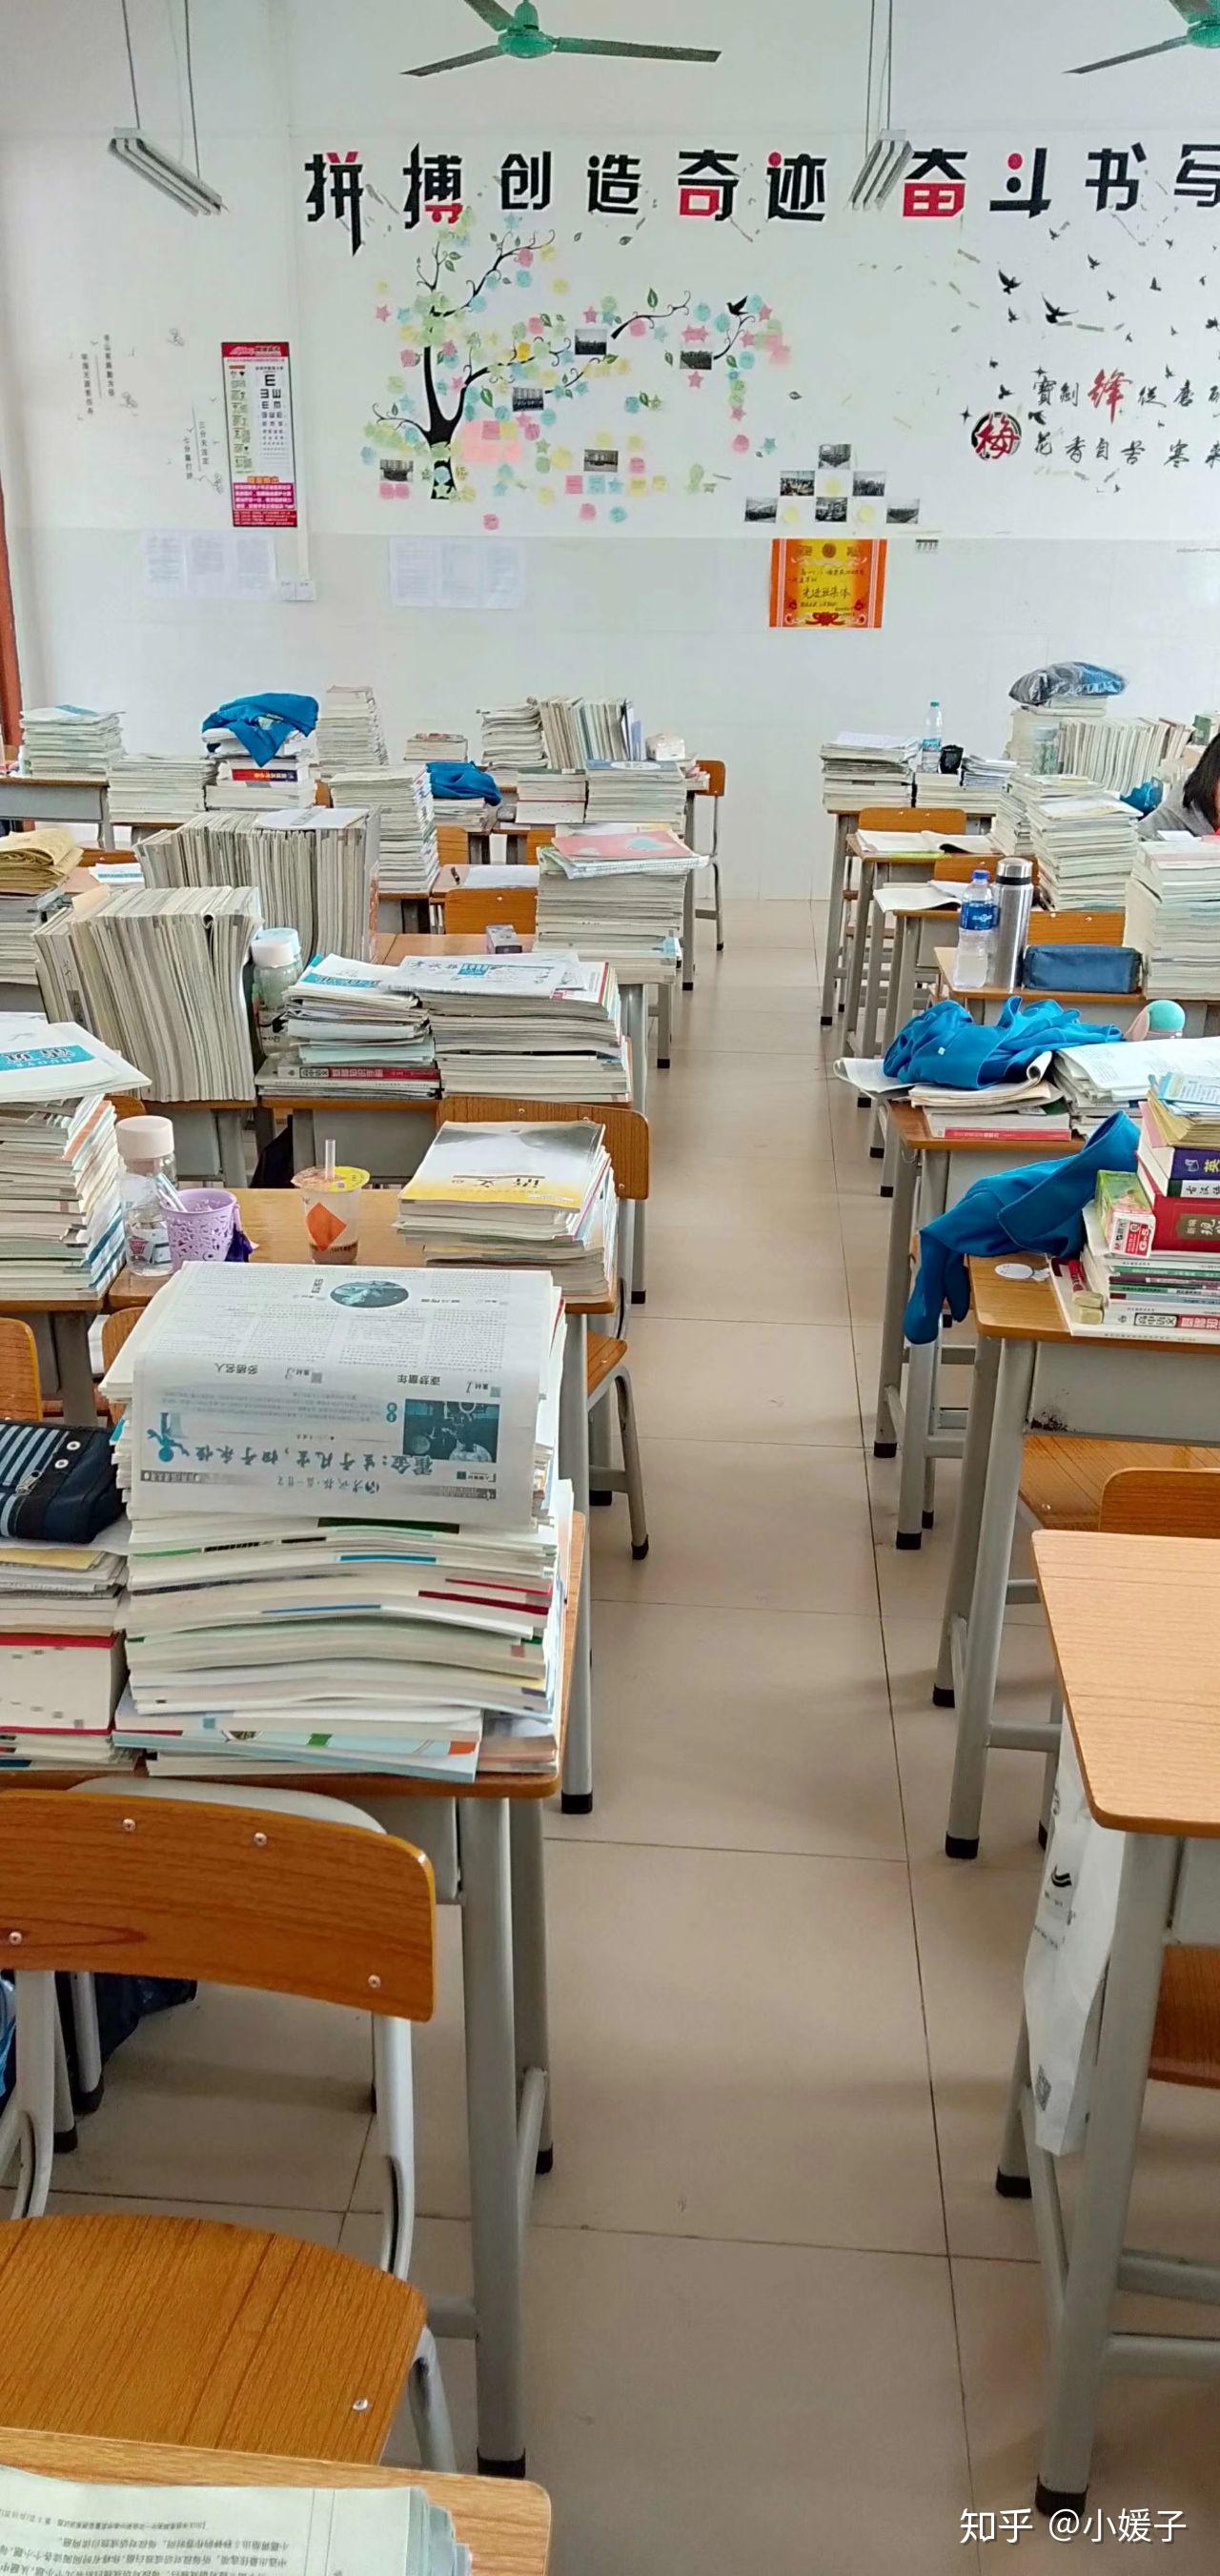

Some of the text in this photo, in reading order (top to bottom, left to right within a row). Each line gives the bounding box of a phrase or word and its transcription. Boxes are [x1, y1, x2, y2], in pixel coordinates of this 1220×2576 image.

[304, 142, 1220, 257] 拼搏创造奇迹 奋斗书写
[1138, 1313, 1175, 1326] 高中语文
